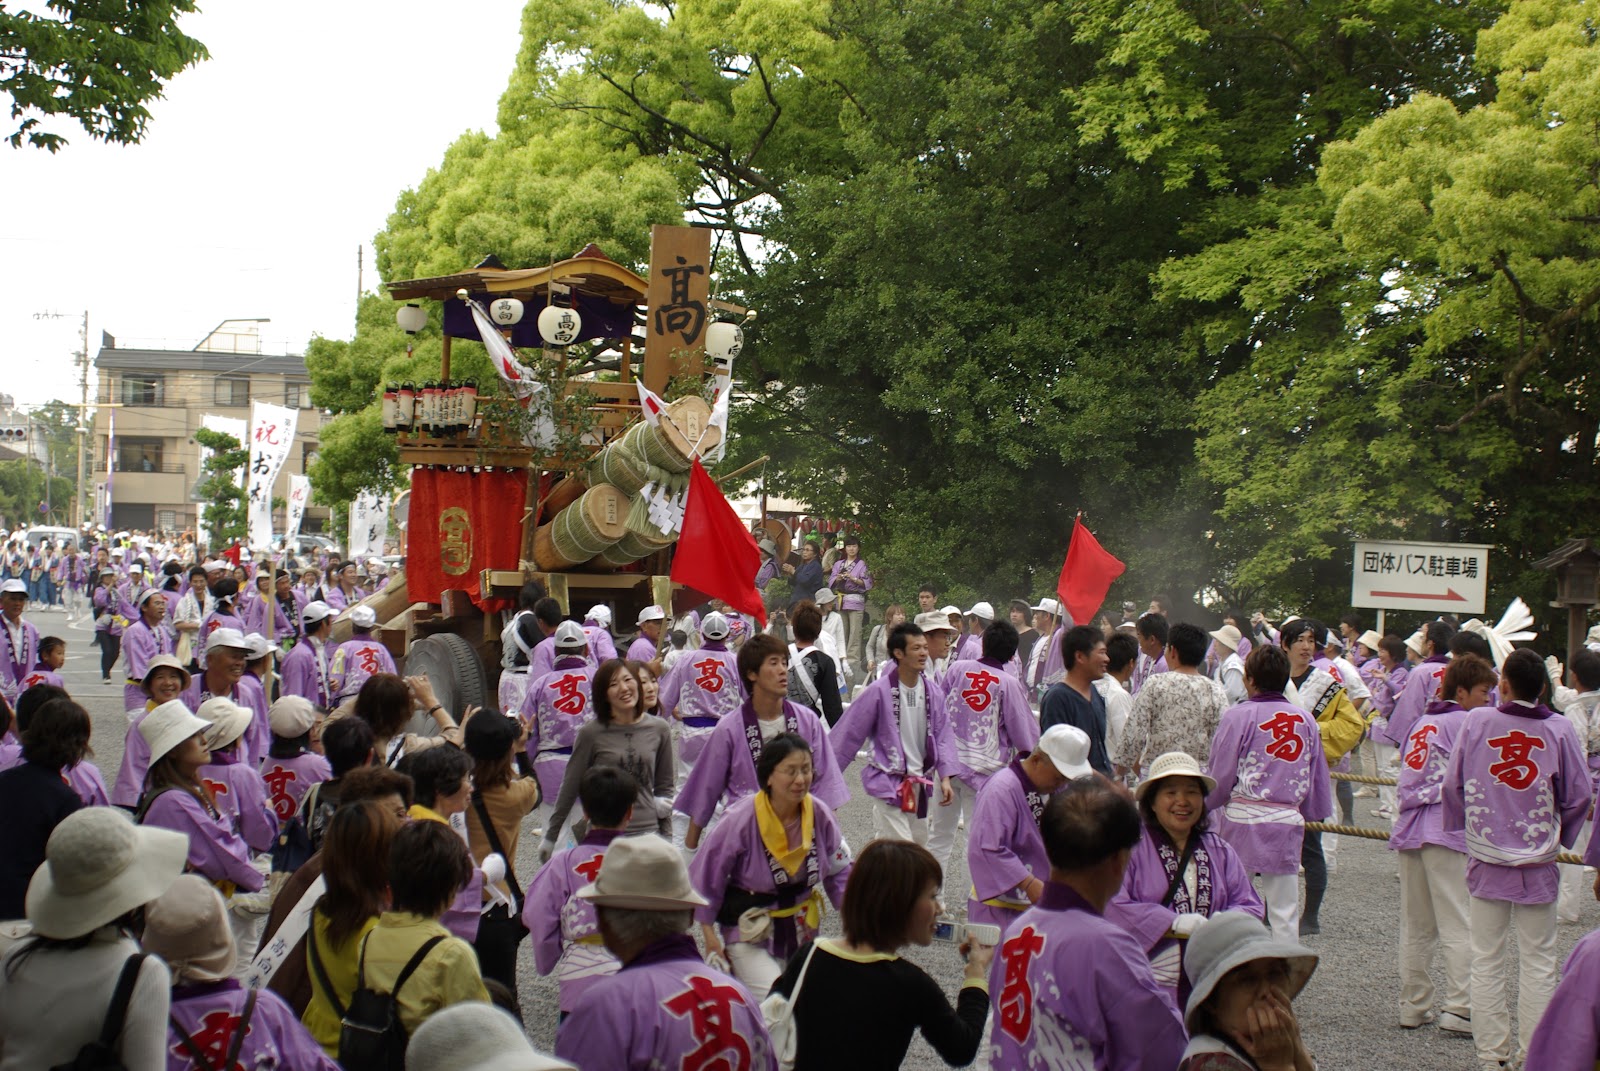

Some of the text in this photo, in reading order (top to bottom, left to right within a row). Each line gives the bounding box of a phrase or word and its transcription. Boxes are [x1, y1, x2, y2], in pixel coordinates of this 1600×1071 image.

[498, 300, 513, 321] 高向
[555, 312, 575, 342] 高向
[1363, 551, 1478, 579] 団体バス駐車場
